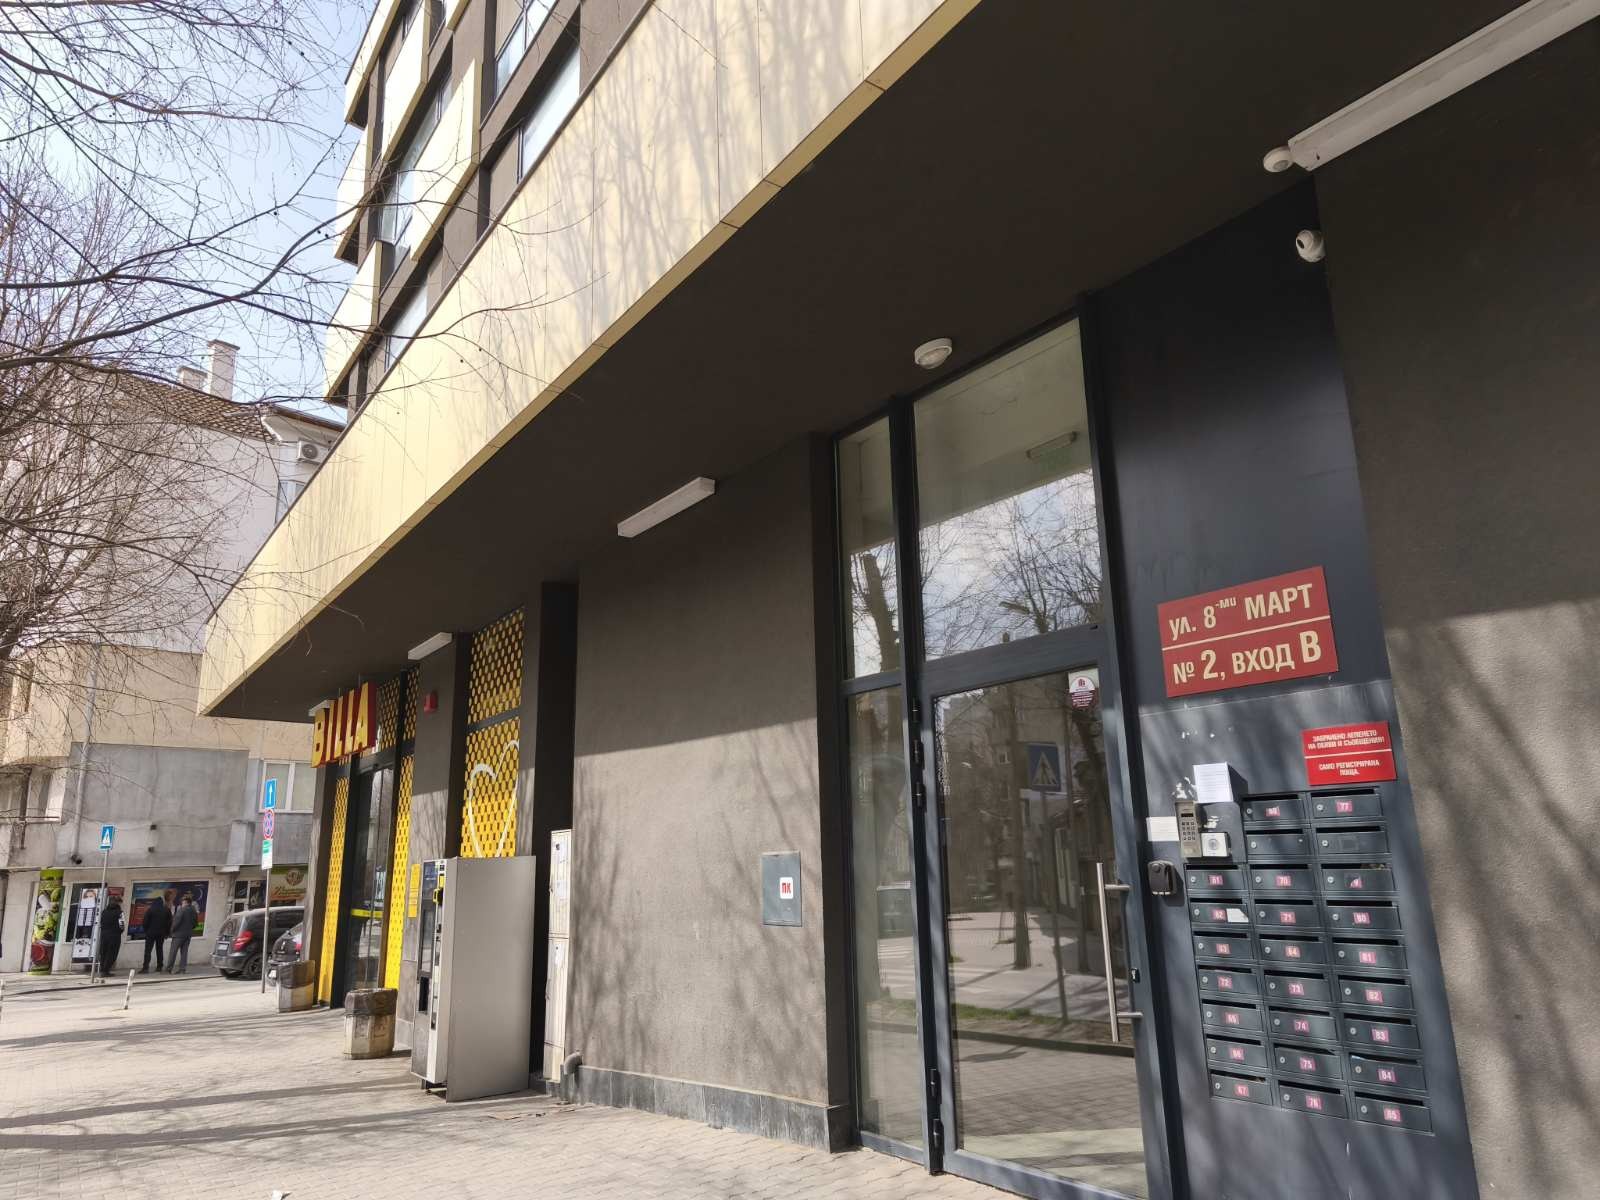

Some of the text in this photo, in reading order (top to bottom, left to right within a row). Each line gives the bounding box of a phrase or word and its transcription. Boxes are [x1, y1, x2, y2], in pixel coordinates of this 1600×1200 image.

[1169, 616, 1197, 641] ул.
[1244, 583, 1313, 621] МАРТ
[1173, 661, 1195, 685] №
[1200, 649, 1226, 681] 2,
[311, 680, 373, 768] BILLA
[781, 882, 792, 894] ПК
